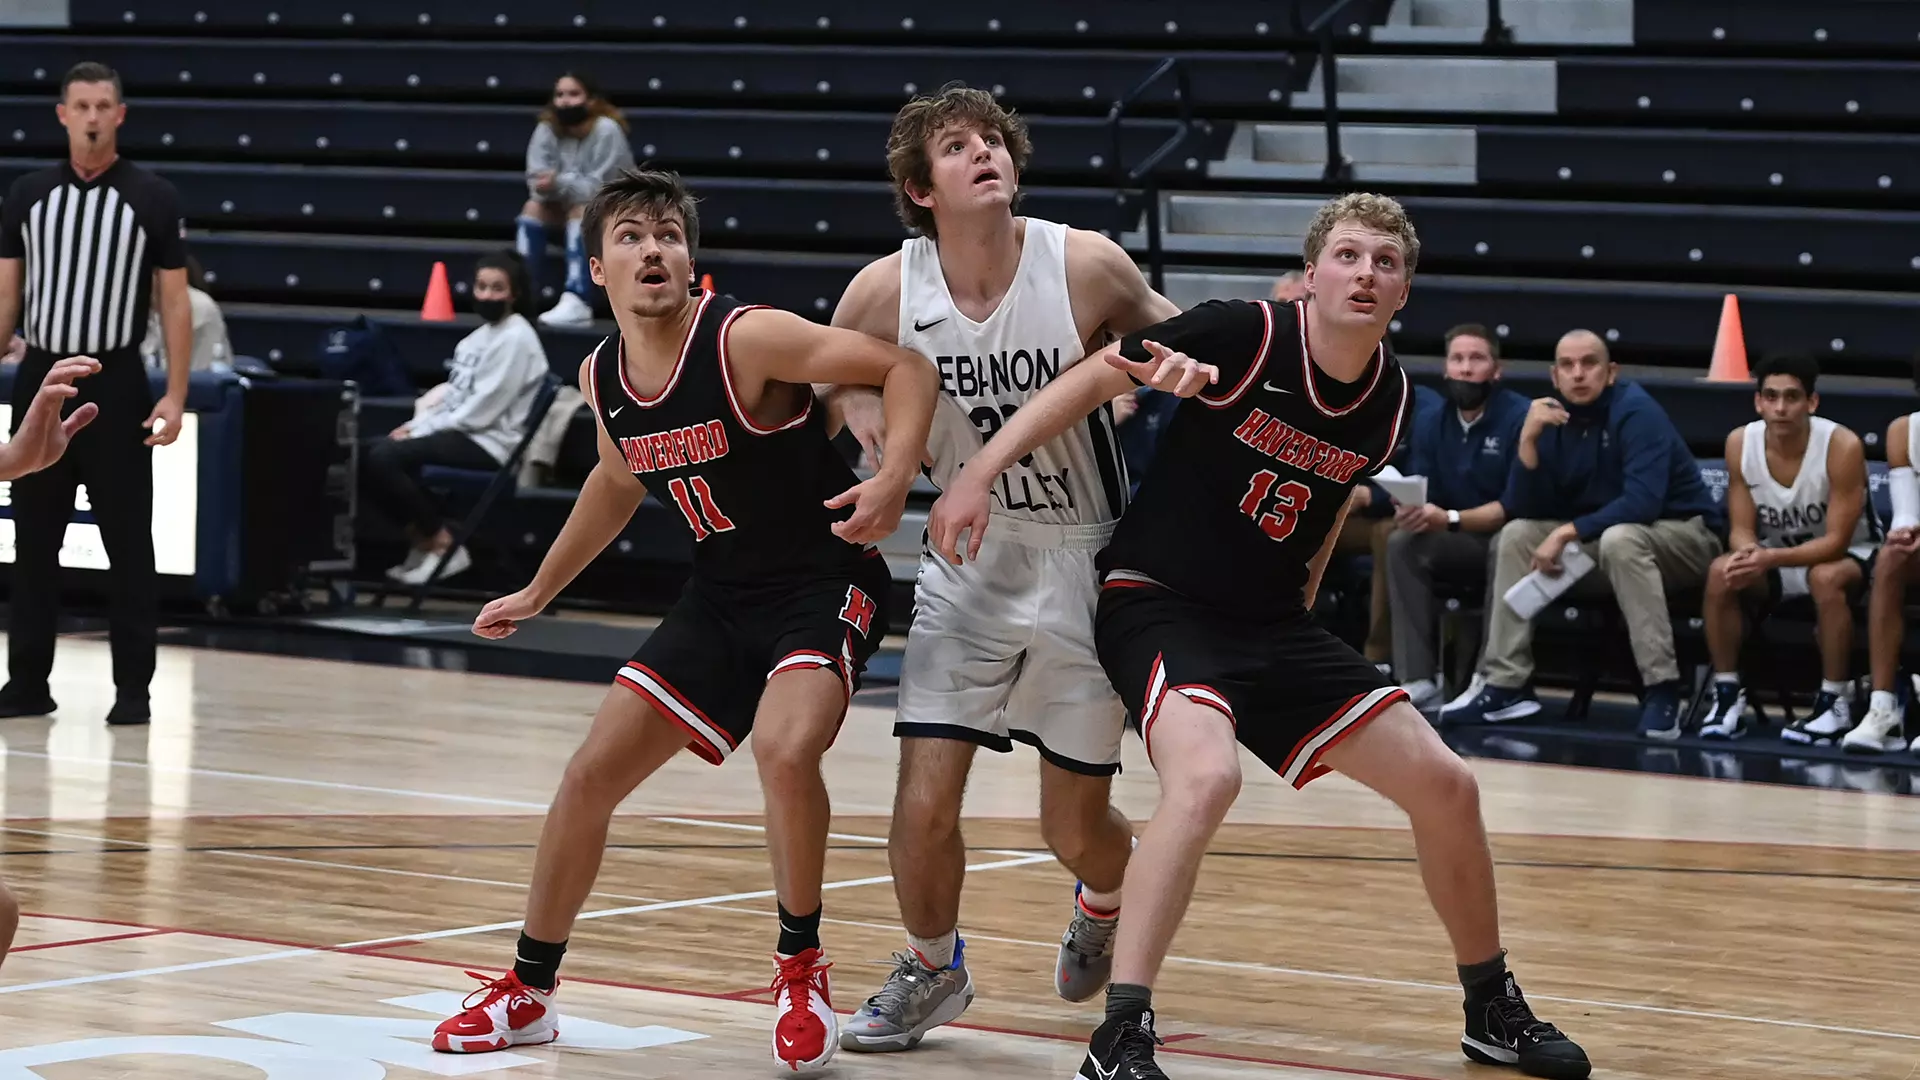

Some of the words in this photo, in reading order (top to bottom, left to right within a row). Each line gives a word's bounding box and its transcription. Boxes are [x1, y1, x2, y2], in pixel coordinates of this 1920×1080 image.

[935, 347, 1060, 397] EBANON
[619, 419, 730, 474] HAVERFORD
[1233, 408, 1369, 484] HAVERFORD
[667, 475, 736, 542] 11
[1238, 468, 1312, 542] 13
[838, 583, 877, 640] H
